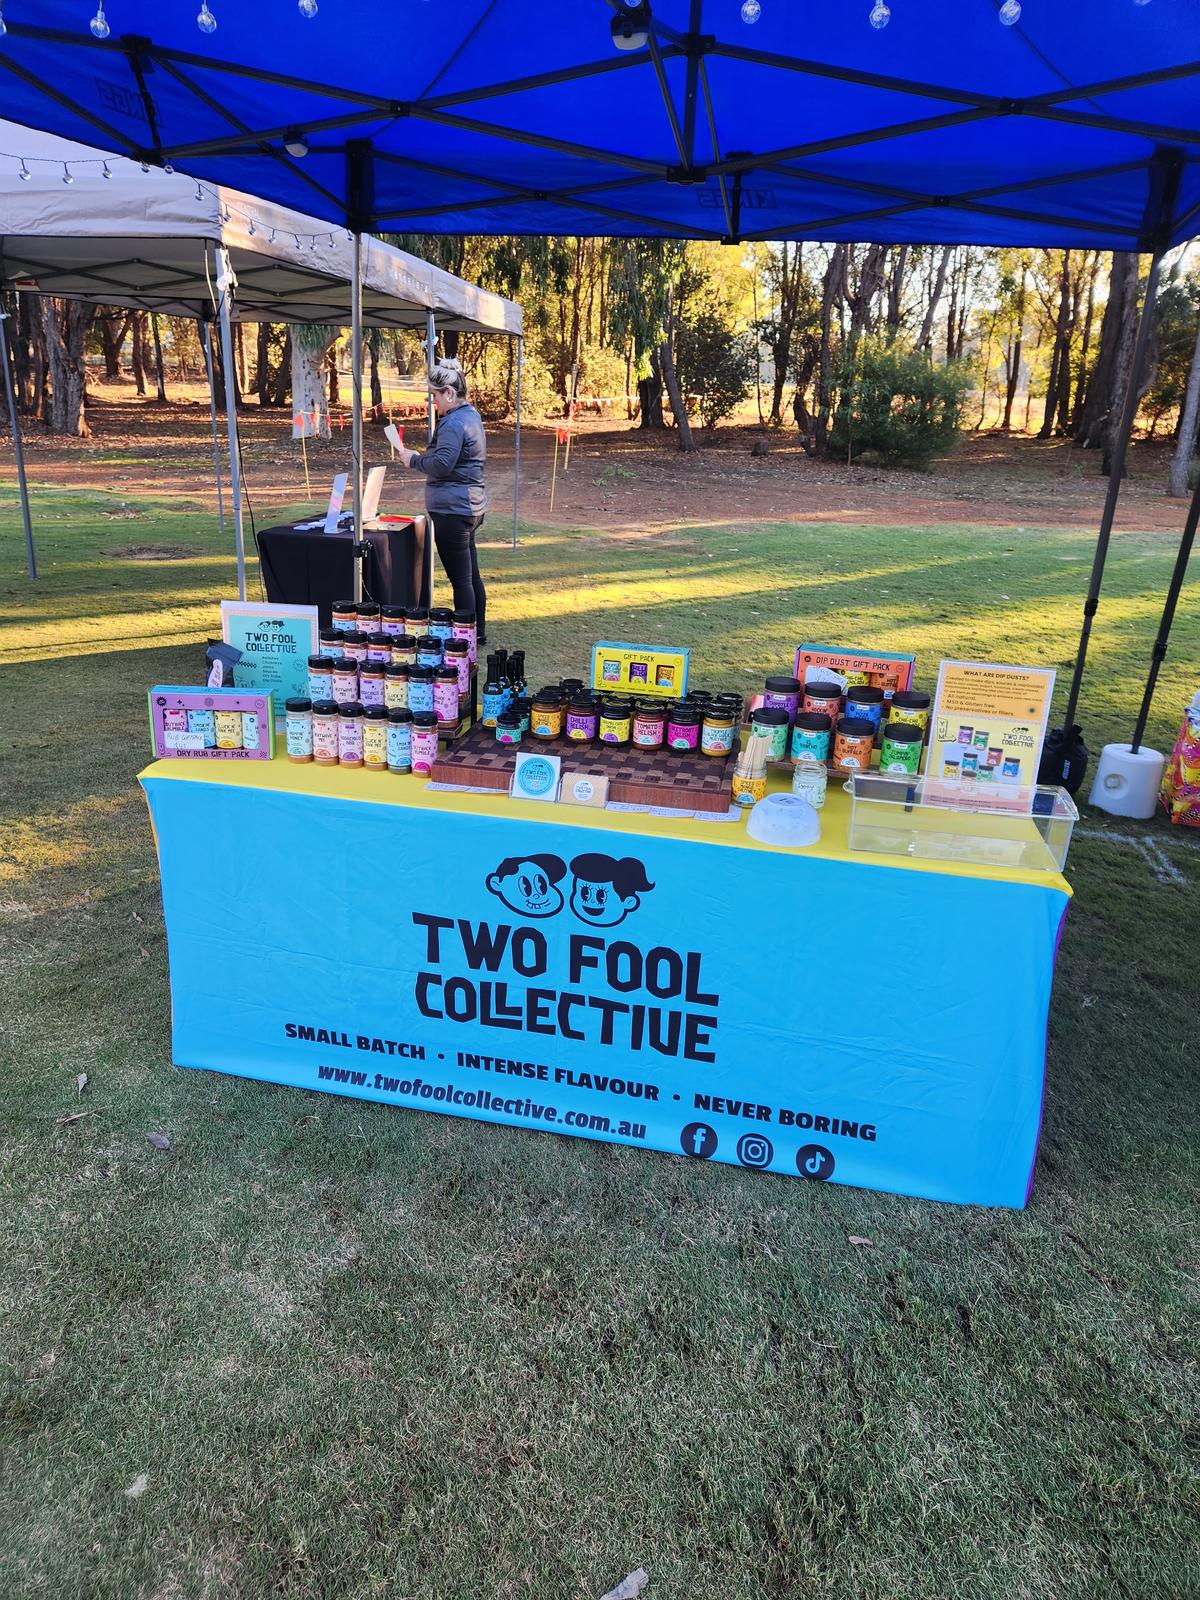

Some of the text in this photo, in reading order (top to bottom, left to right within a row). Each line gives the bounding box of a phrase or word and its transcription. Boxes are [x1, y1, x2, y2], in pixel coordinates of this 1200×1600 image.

[245, 632, 297, 644] TWO FOOL
[245, 642, 297, 654] COLLECTIVE
[815, 656, 891, 671] DIP DUST GIFT PACK
[1006, 673, 1030, 681] DUSTS?
[570, 716, 588, 724] CHILLI
[1002, 739, 1034, 748] COLLECTIVE
[1018, 734, 1034, 743] FOOL
[412, 912, 719, 1007] TWO FOOL
[415, 972, 718, 1063] COLLECTIVE
[285, 1023, 877, 1142] SMALL BATCH INTENSE FLAVOUR NEVER BORING
[317, 1065, 647, 1139] www.twofoolcollective.com.au
